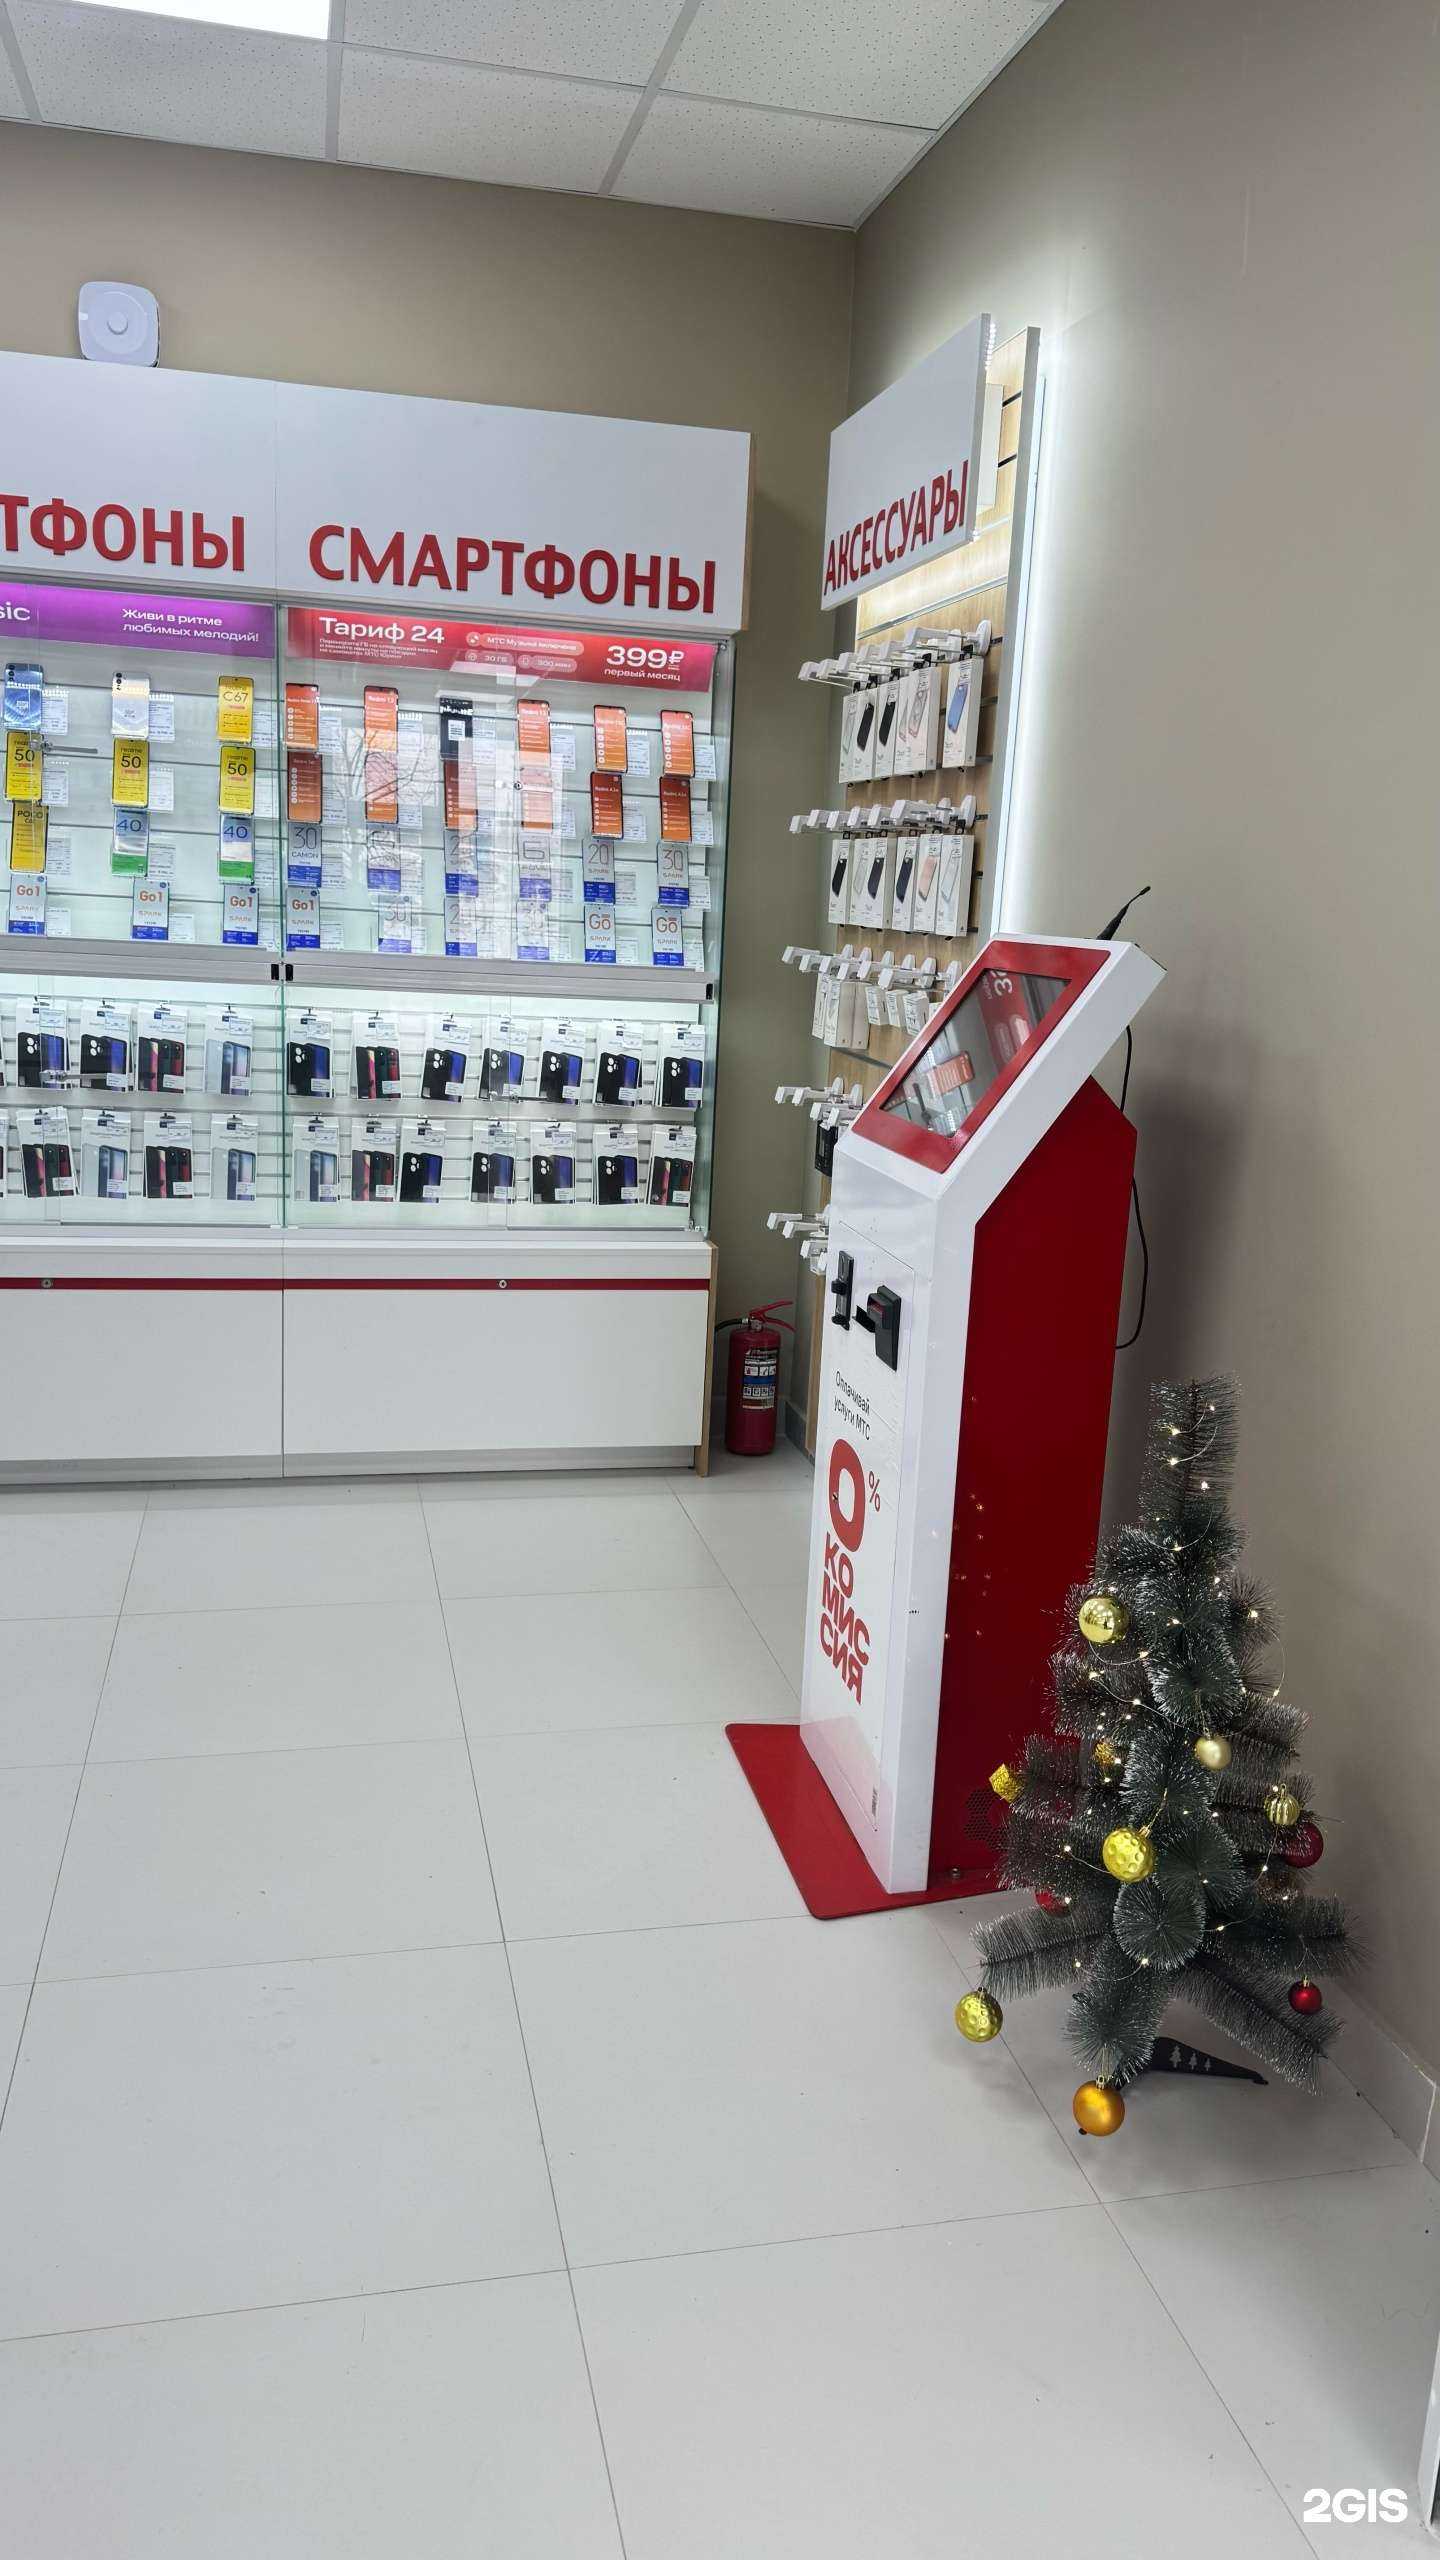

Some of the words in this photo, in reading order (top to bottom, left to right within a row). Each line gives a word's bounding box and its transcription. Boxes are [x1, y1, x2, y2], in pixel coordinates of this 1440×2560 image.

[0, 494, 245, 571] ТФОНЫ
[823, 459, 969, 596] АКСЕССУАРЫ
[308, 524, 716, 613] СМАРТФОНЫ
[122, 608, 164, 622] Живи
[167, 614, 177, 622] в
[178, 613, 223, 627] ритме
[123, 623, 191, 637] любимых
[193, 628, 259, 643] мелодий!
[319, 616, 405, 644] Тариф
[411, 625, 445, 644] 24
[604, 668, 646, 678] первый
[647, 672, 681, 682] месяц
[223, 691, 249, 703] C67
[14, 749, 35, 762] 50
[120, 755, 141, 769] 50
[227, 762, 248, 776] 50
[116, 819, 142, 832] 40
[223, 826, 248, 839] 40
[293, 826, 317, 849] 30
[588, 843, 609, 865] 20
[662, 849, 684, 871] 30
[589, 913, 611, 930] Go
[656, 917, 678, 933] Go
[835, 1371, 870, 1416] Оплачивай
[834, 1396, 855, 1426] услуги
[855, 1415, 871, 1440] МТС
[828, 1438, 866, 1552] 0
[868, 1471, 881, 1512] %
[824, 1531, 854, 1599] КО
[822, 1571, 871, 1666] МИС
[820, 1613, 864, 1705] СИЯ
